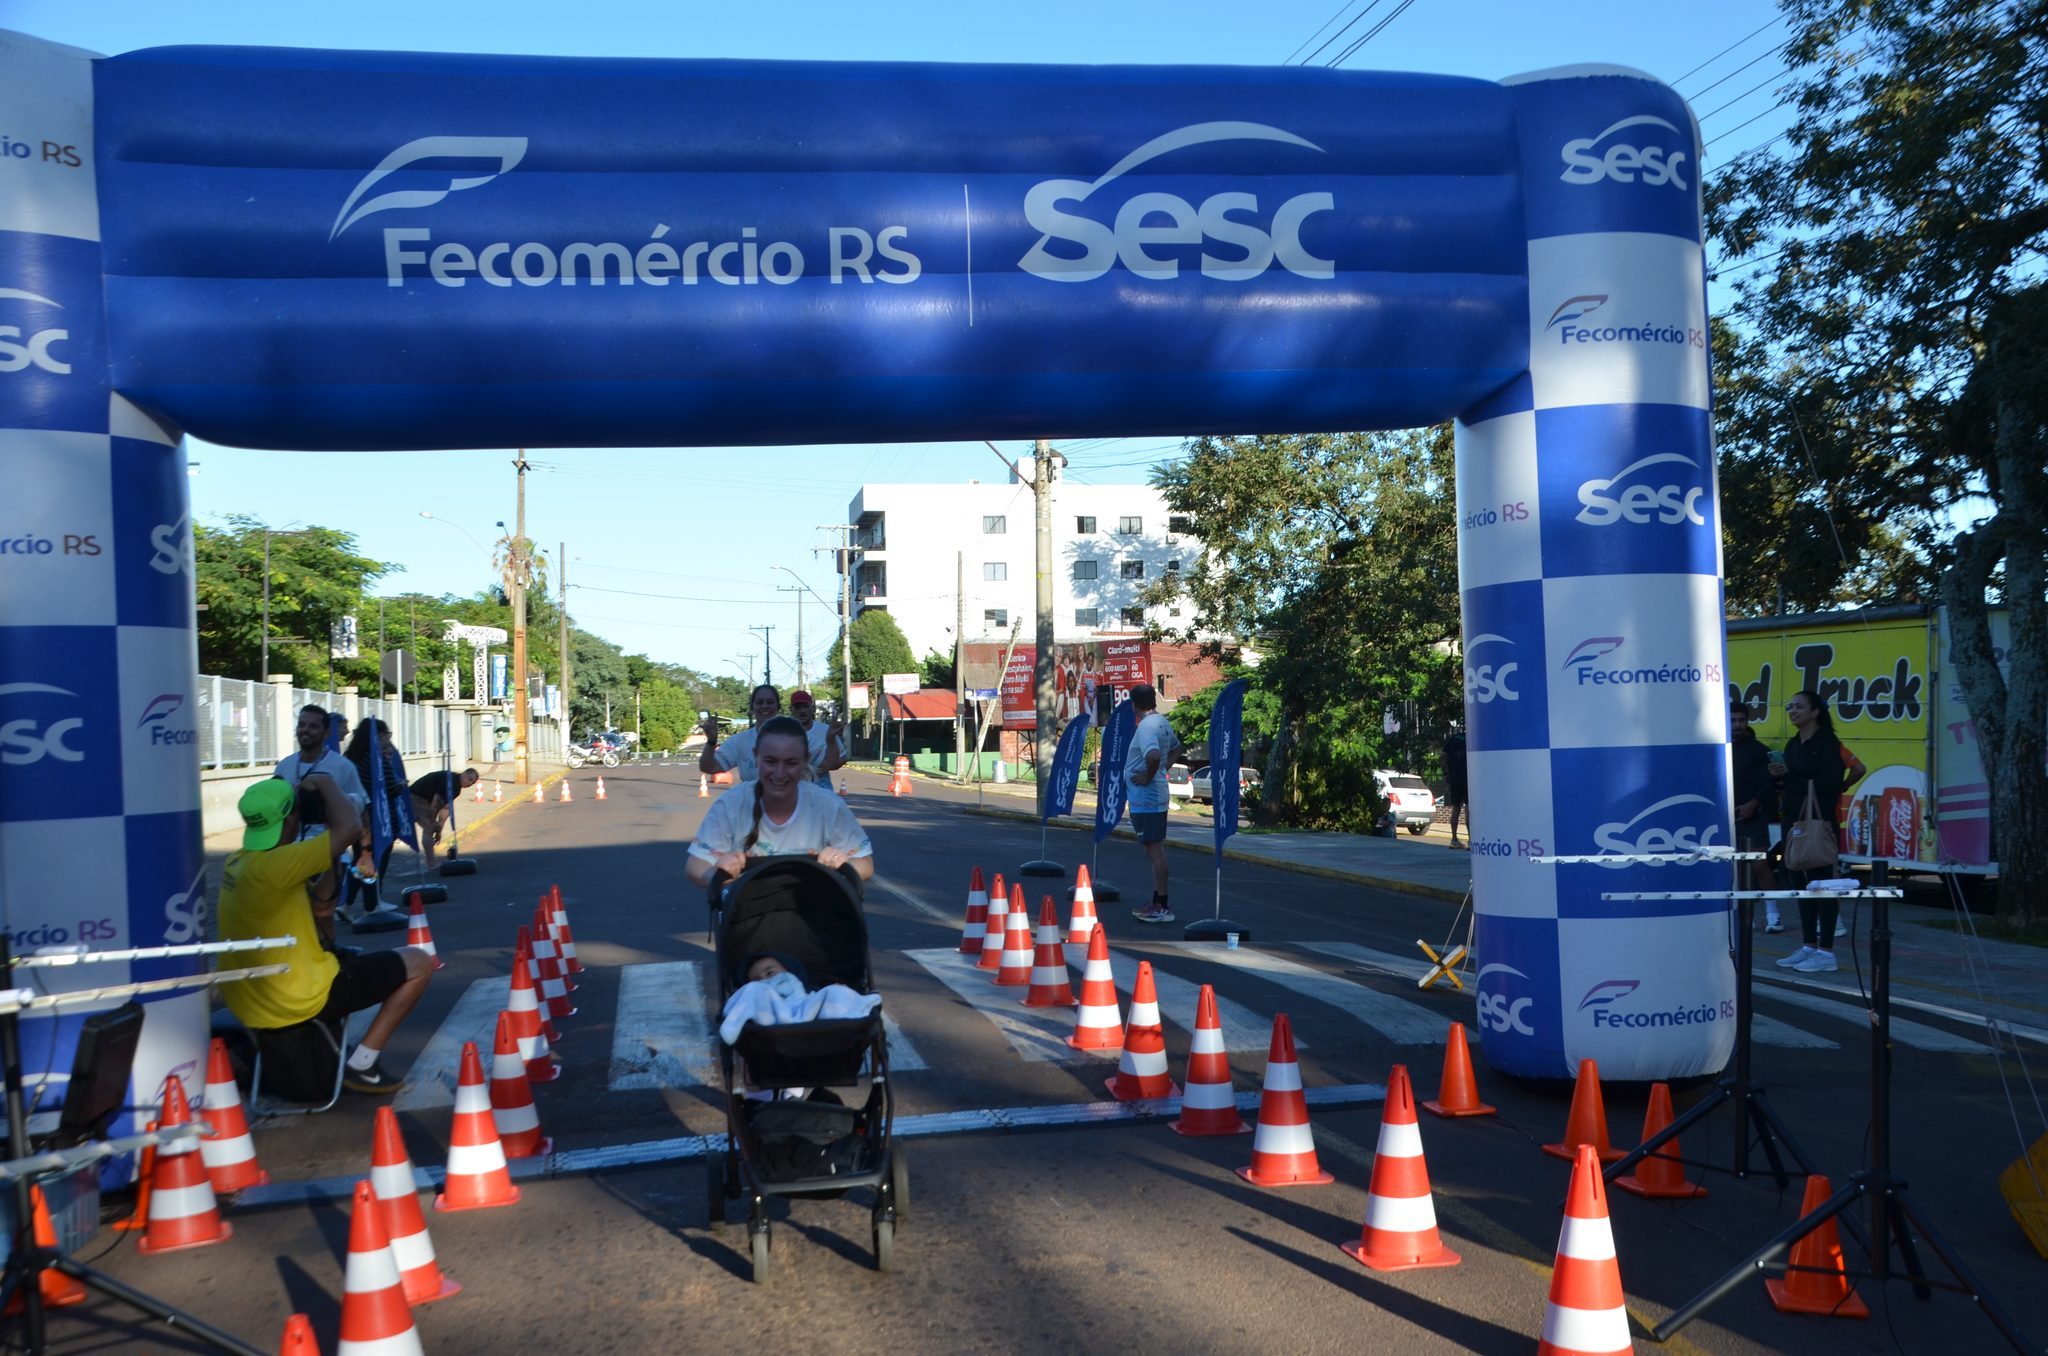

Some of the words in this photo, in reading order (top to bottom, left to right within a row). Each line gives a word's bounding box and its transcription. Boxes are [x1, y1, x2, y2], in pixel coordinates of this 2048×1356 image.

[42, 141, 82, 168] RS
[1560, 138, 1687, 190] Sesc
[1017, 179, 1335, 282] Sesc
[384, 224, 804, 287] Fecomércio
[828, 226, 921, 285] RS
[1561, 322, 1684, 344] Fecomércio
[1688, 328, 1704, 348] RS
[1503, 502, 1529, 521] RS
[1575, 479, 1704, 525] Sesc
[63, 535, 102, 556] RS
[1578, 664, 1701, 685] Fecomércio
[1705, 665, 1721, 682] RS
[1795, 643, 1922, 722] Truck
[1057, 768, 1071, 808] Sesc
[1104, 771, 1120, 824] Sesc
[1517, 839, 1545, 857] RS
[1592, 822, 1719, 869] Sesc
[79, 918, 117, 942] RS
[1594, 1005, 1716, 1027] Fecomércio
[1720, 999, 1734, 1019] RS
